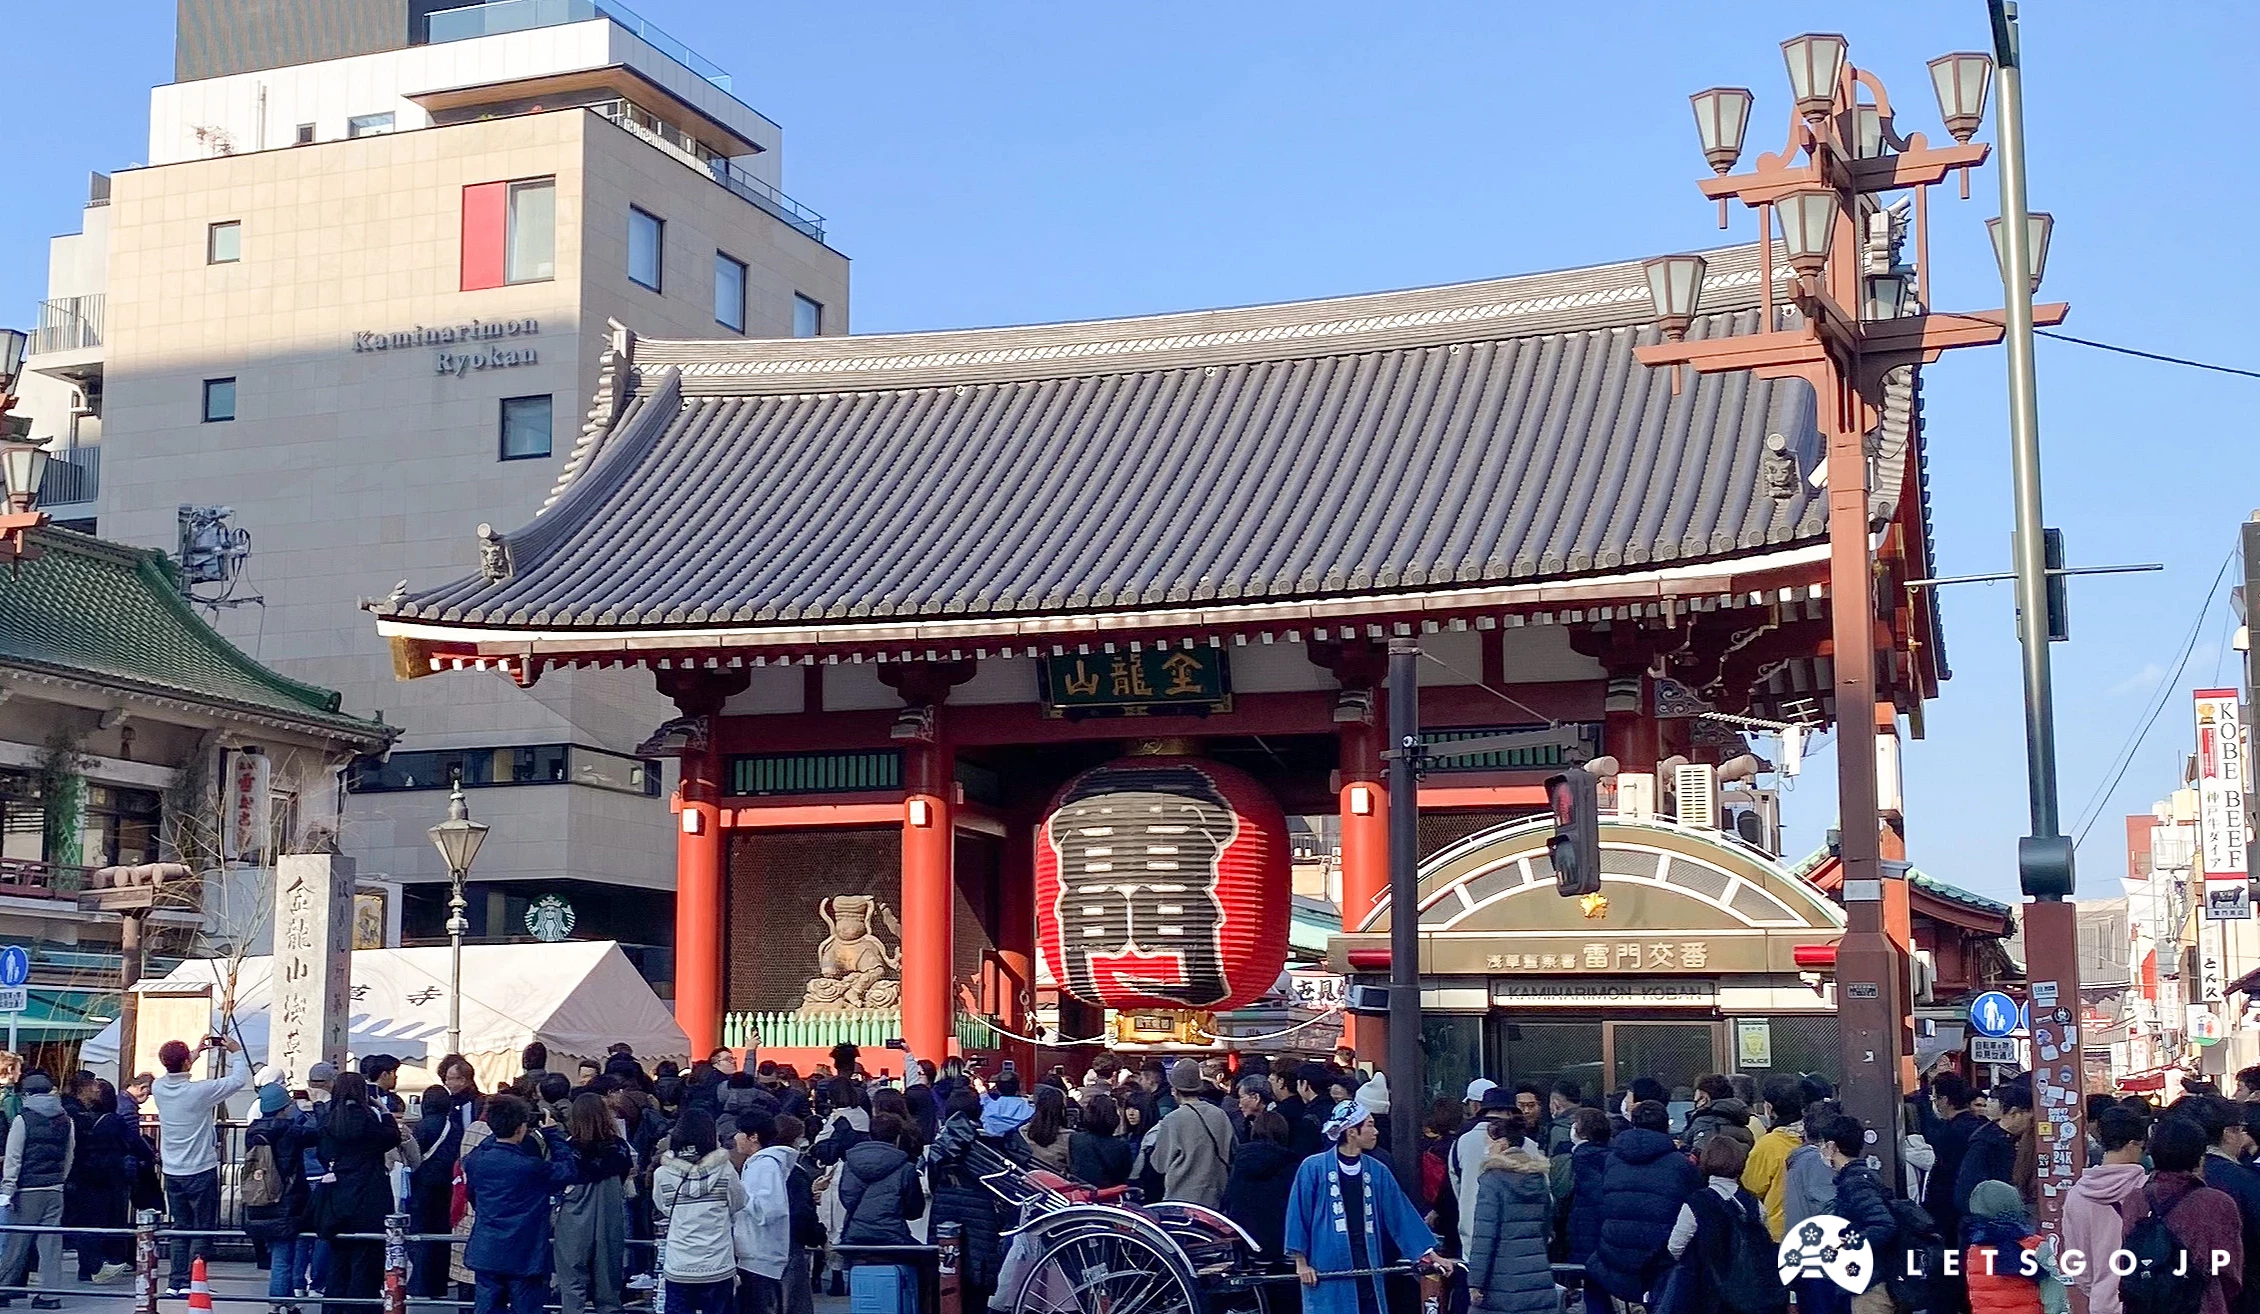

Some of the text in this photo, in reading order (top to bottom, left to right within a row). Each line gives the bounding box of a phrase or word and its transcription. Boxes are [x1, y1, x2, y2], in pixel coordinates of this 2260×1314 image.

[352, 318, 539, 353] Kaminarimon
[436, 346, 539, 379] Ryokan
[2219, 702, 2243, 868] KOBE BEEF
[1582, 941, 1709, 970] 雷門交番
[1508, 986, 1701, 1000] KAMINARIMON KOBAN
